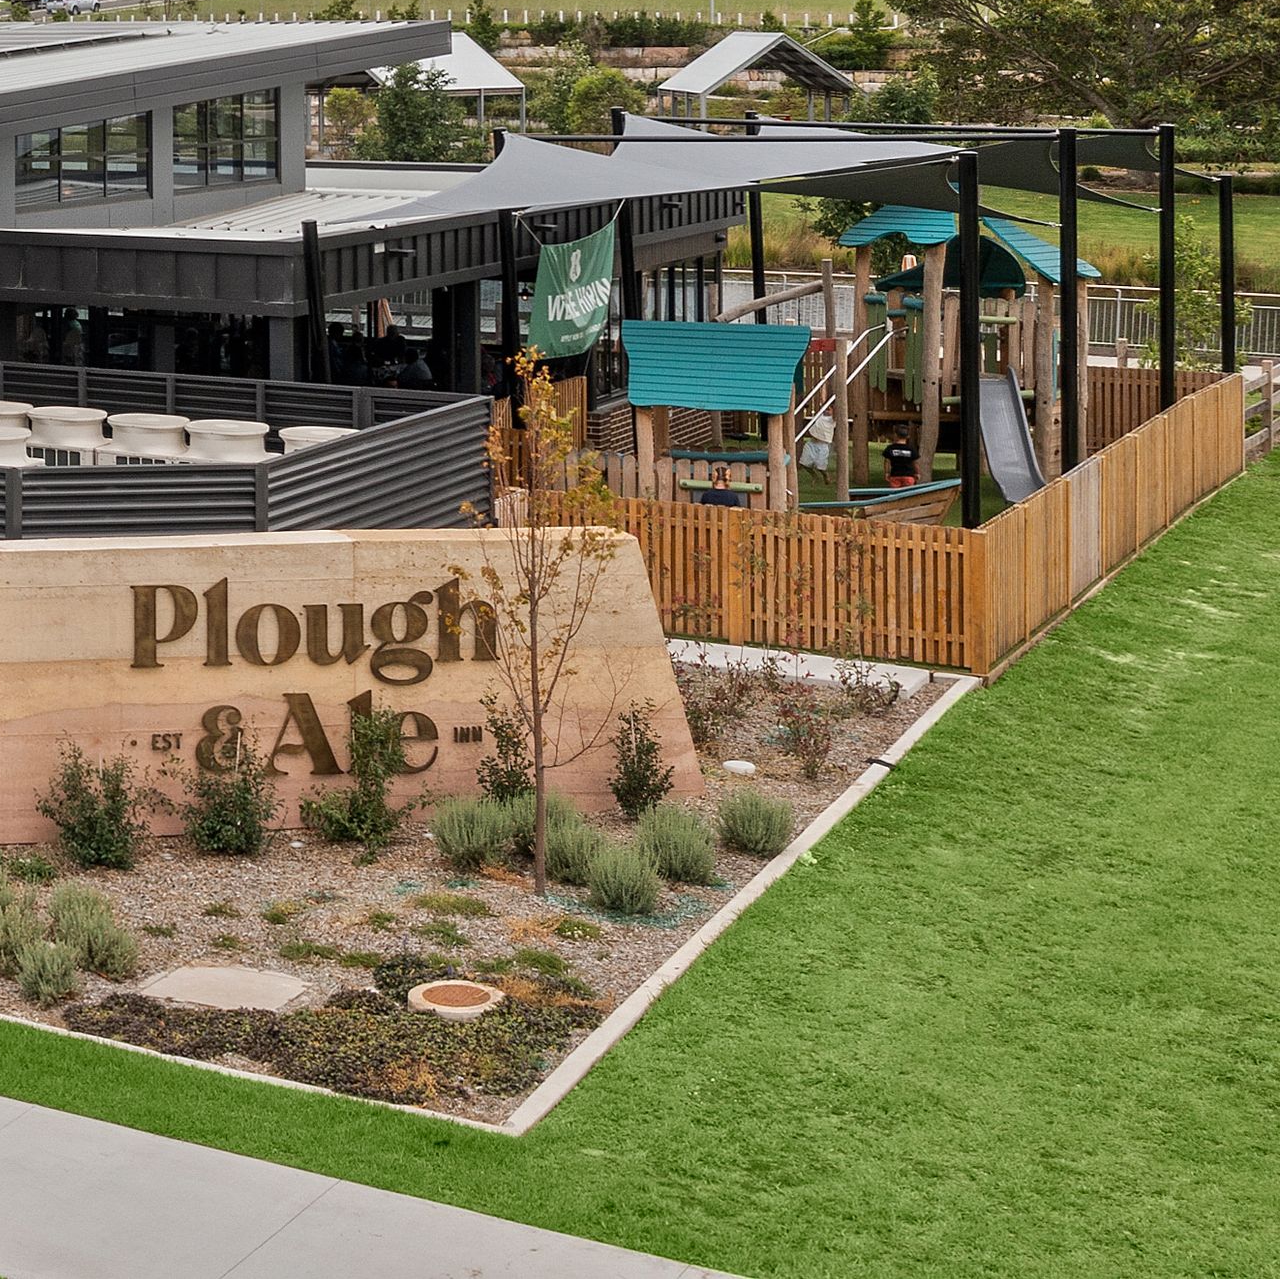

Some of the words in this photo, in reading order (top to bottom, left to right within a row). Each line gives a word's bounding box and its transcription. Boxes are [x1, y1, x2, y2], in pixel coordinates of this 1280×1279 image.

[130, 577, 500, 686] Plough
[151, 732, 183, 752] EST
[453, 725, 483, 743] INN
